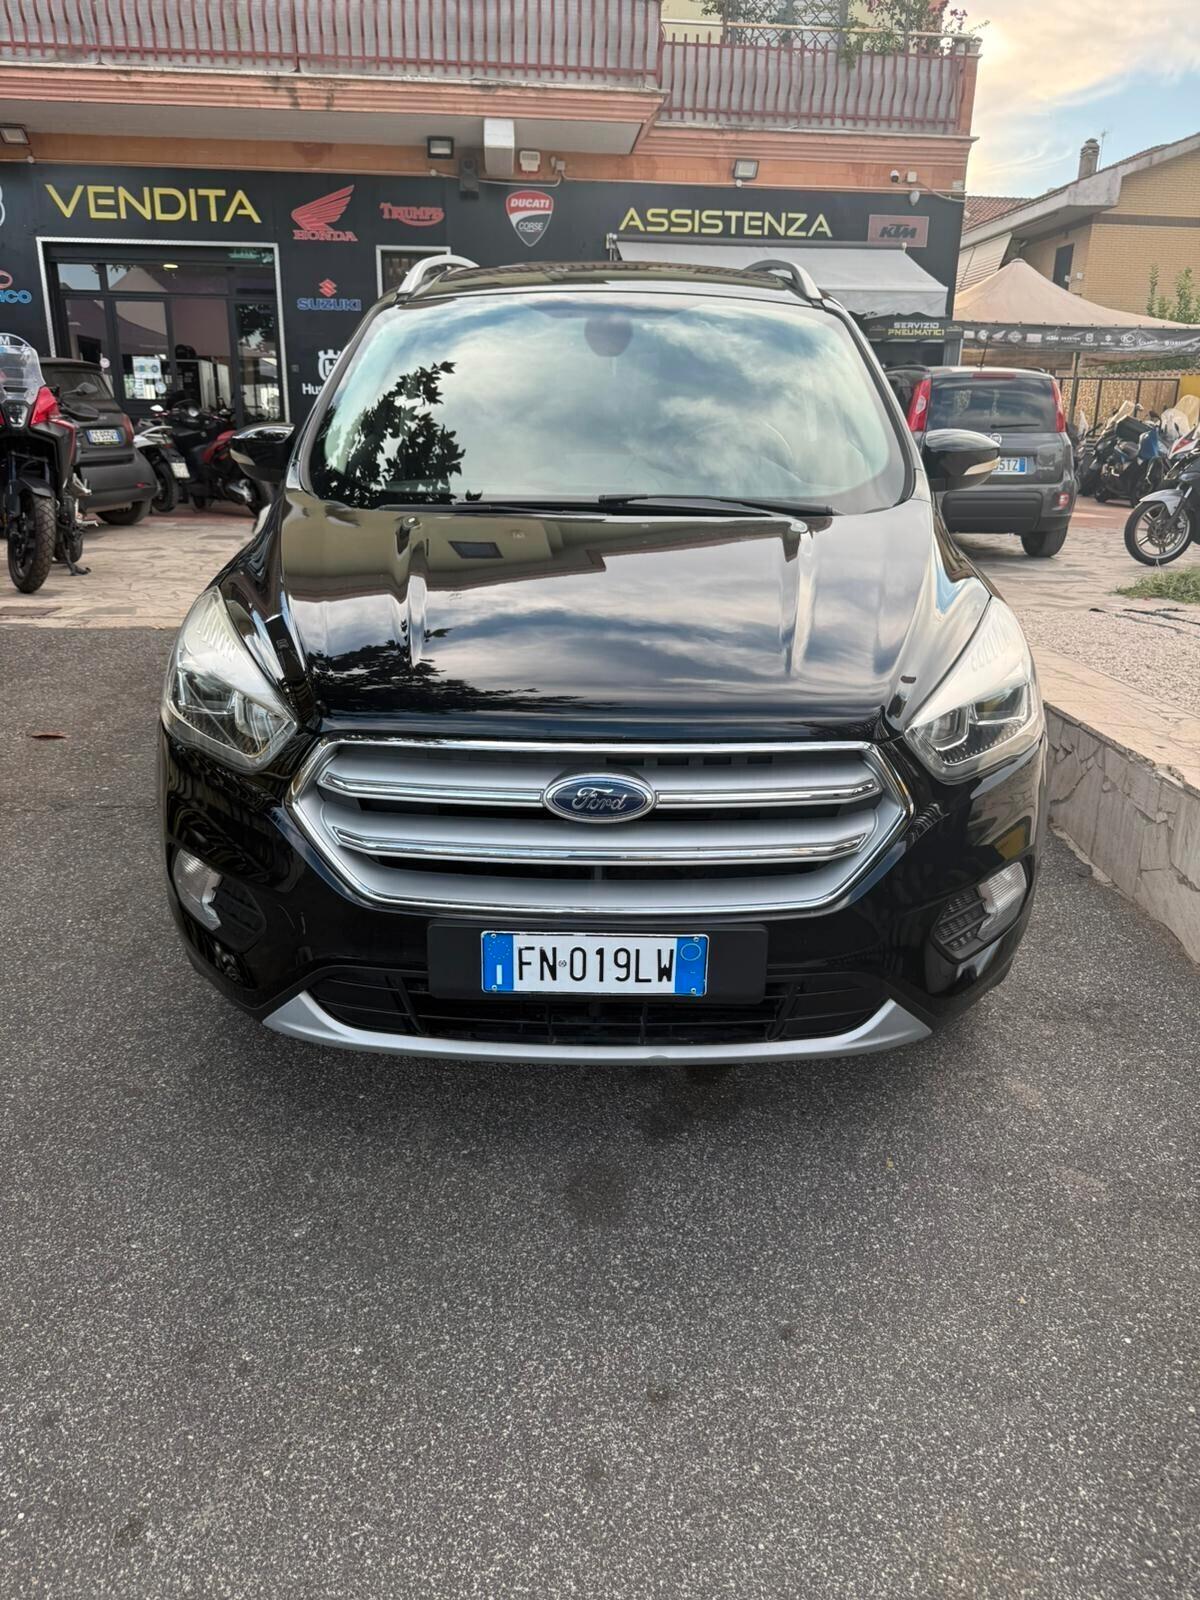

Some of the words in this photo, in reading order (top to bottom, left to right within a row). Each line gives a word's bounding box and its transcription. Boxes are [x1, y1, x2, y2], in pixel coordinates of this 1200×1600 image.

[45, 183, 262, 224] VENDITA
[510, 198, 550, 208] DUCATI
[518, 221, 544, 232] CORSE
[619, 207, 833, 238] ASSISTENZA
[293, 229, 358, 242] HONDA
[879, 223, 918, 239] KTM
[297, 297, 361, 311] SUZUKI
[893, 321, 940, 329] SERVIZIO
[887, 328, 945, 336] PNEUMATICI
[571, 786, 627, 811] Ford
